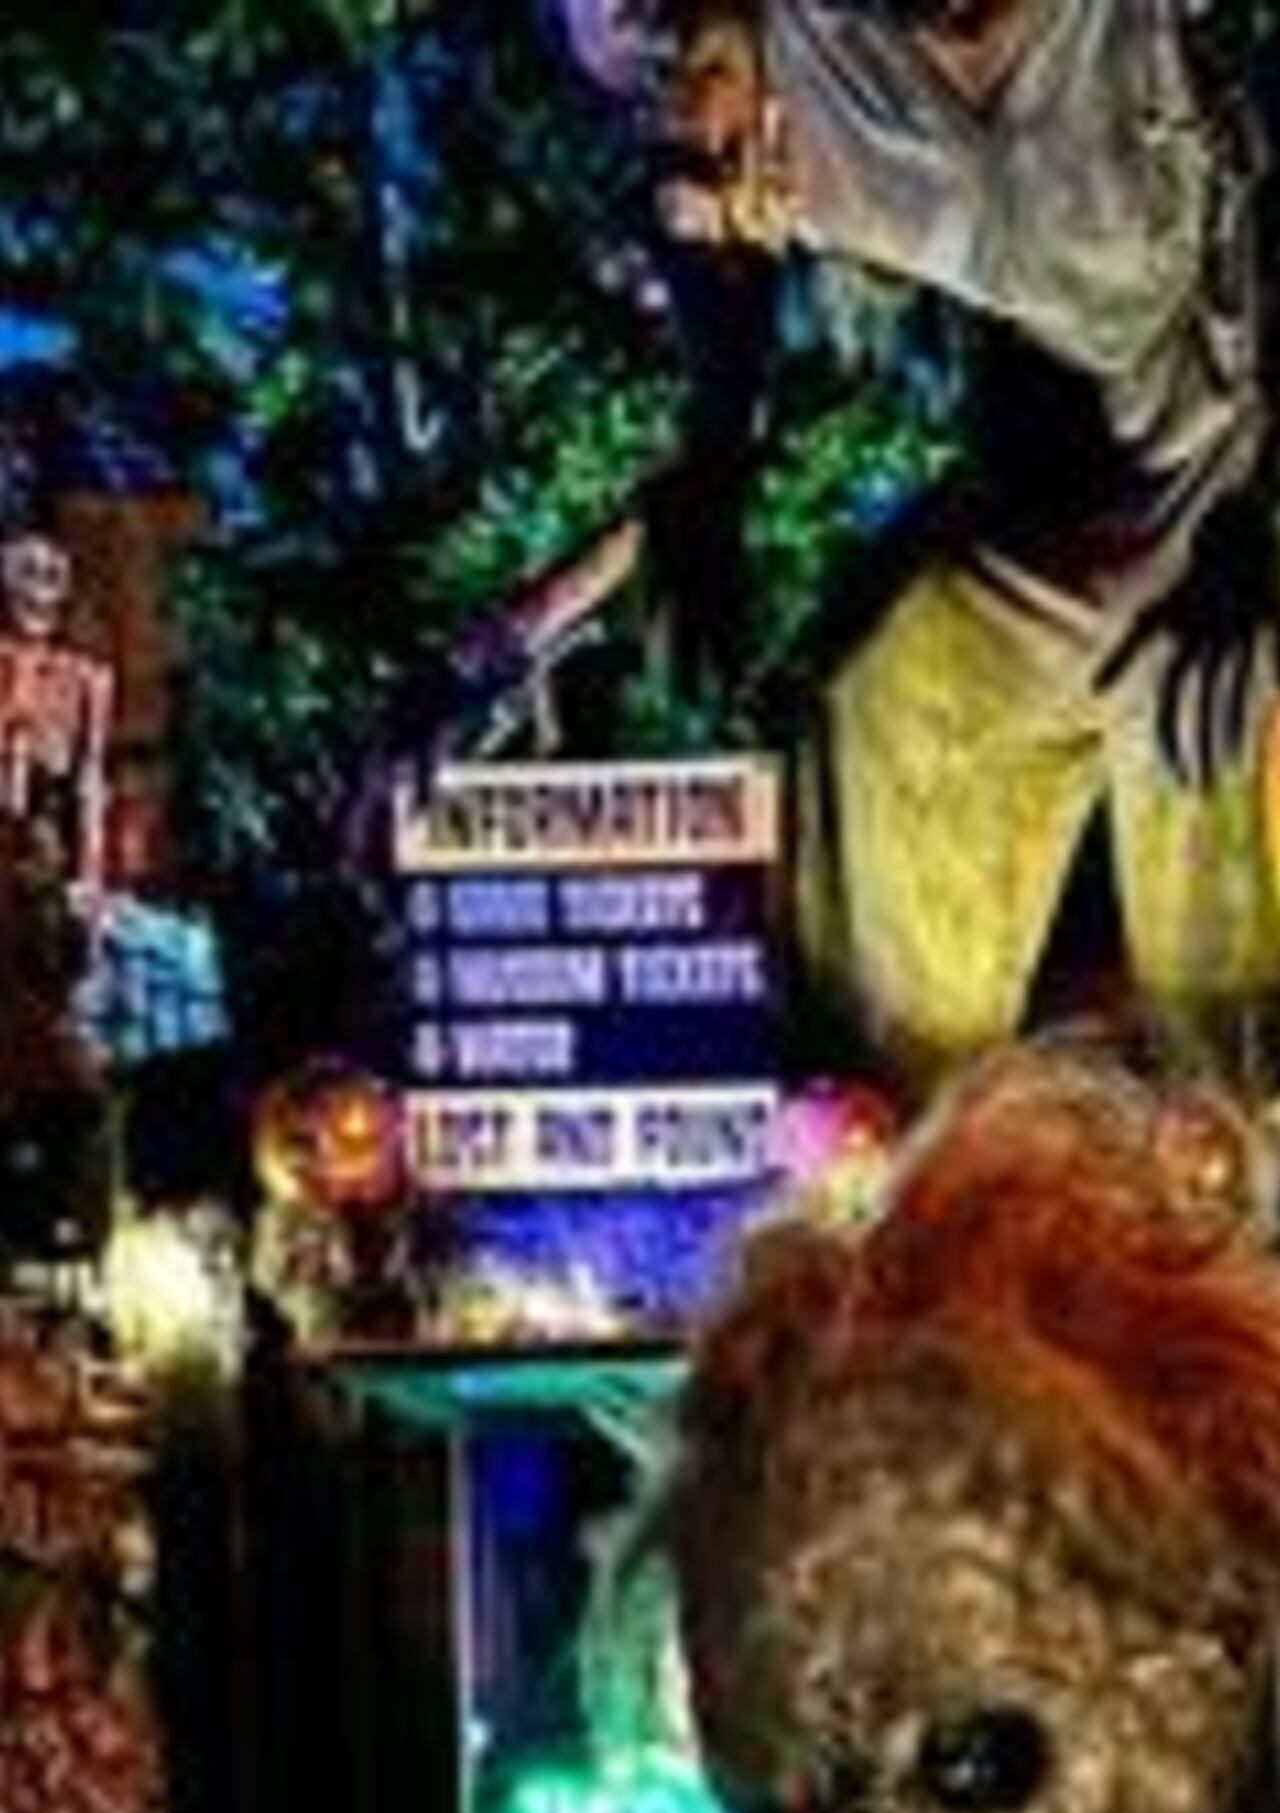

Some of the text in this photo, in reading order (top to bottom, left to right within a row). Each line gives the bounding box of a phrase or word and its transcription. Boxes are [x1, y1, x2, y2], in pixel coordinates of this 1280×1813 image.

[428, 776, 746, 848] INFORMATION
[413, 1107, 511, 1168] LOST
[535, 1107, 616, 1168] AND
